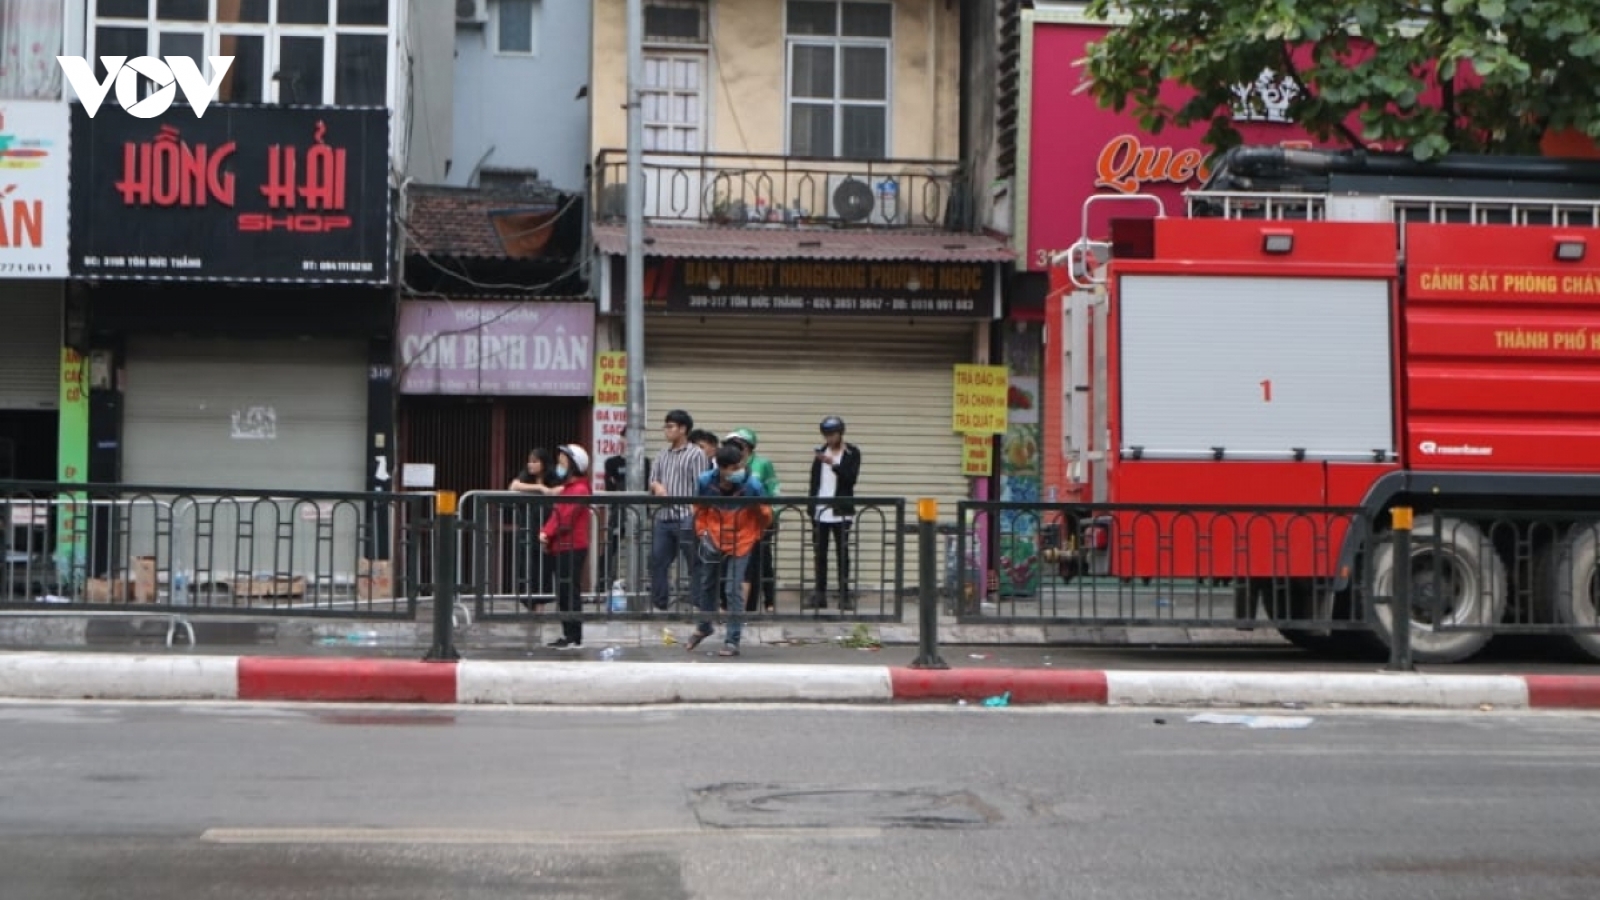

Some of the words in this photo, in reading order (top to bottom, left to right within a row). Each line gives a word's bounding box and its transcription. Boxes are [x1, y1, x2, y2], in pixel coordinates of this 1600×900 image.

[116, 124, 236, 207] HỒNG
[260, 120, 346, 209] HẢI
[238, 215, 352, 231] SHOP
[1420, 266, 1464, 290] CẢNH
[1468, 269, 1498, 291] SÁT
[1504, 271, 1557, 292] PHÒNG
[464, 325, 527, 370] BÌNH
[533, 325, 588, 370] DÂN
[1494, 327, 1548, 349] THÀNH
[1553, 327, 1587, 350] PHỐ
[1260, 379, 1271, 402] 1
